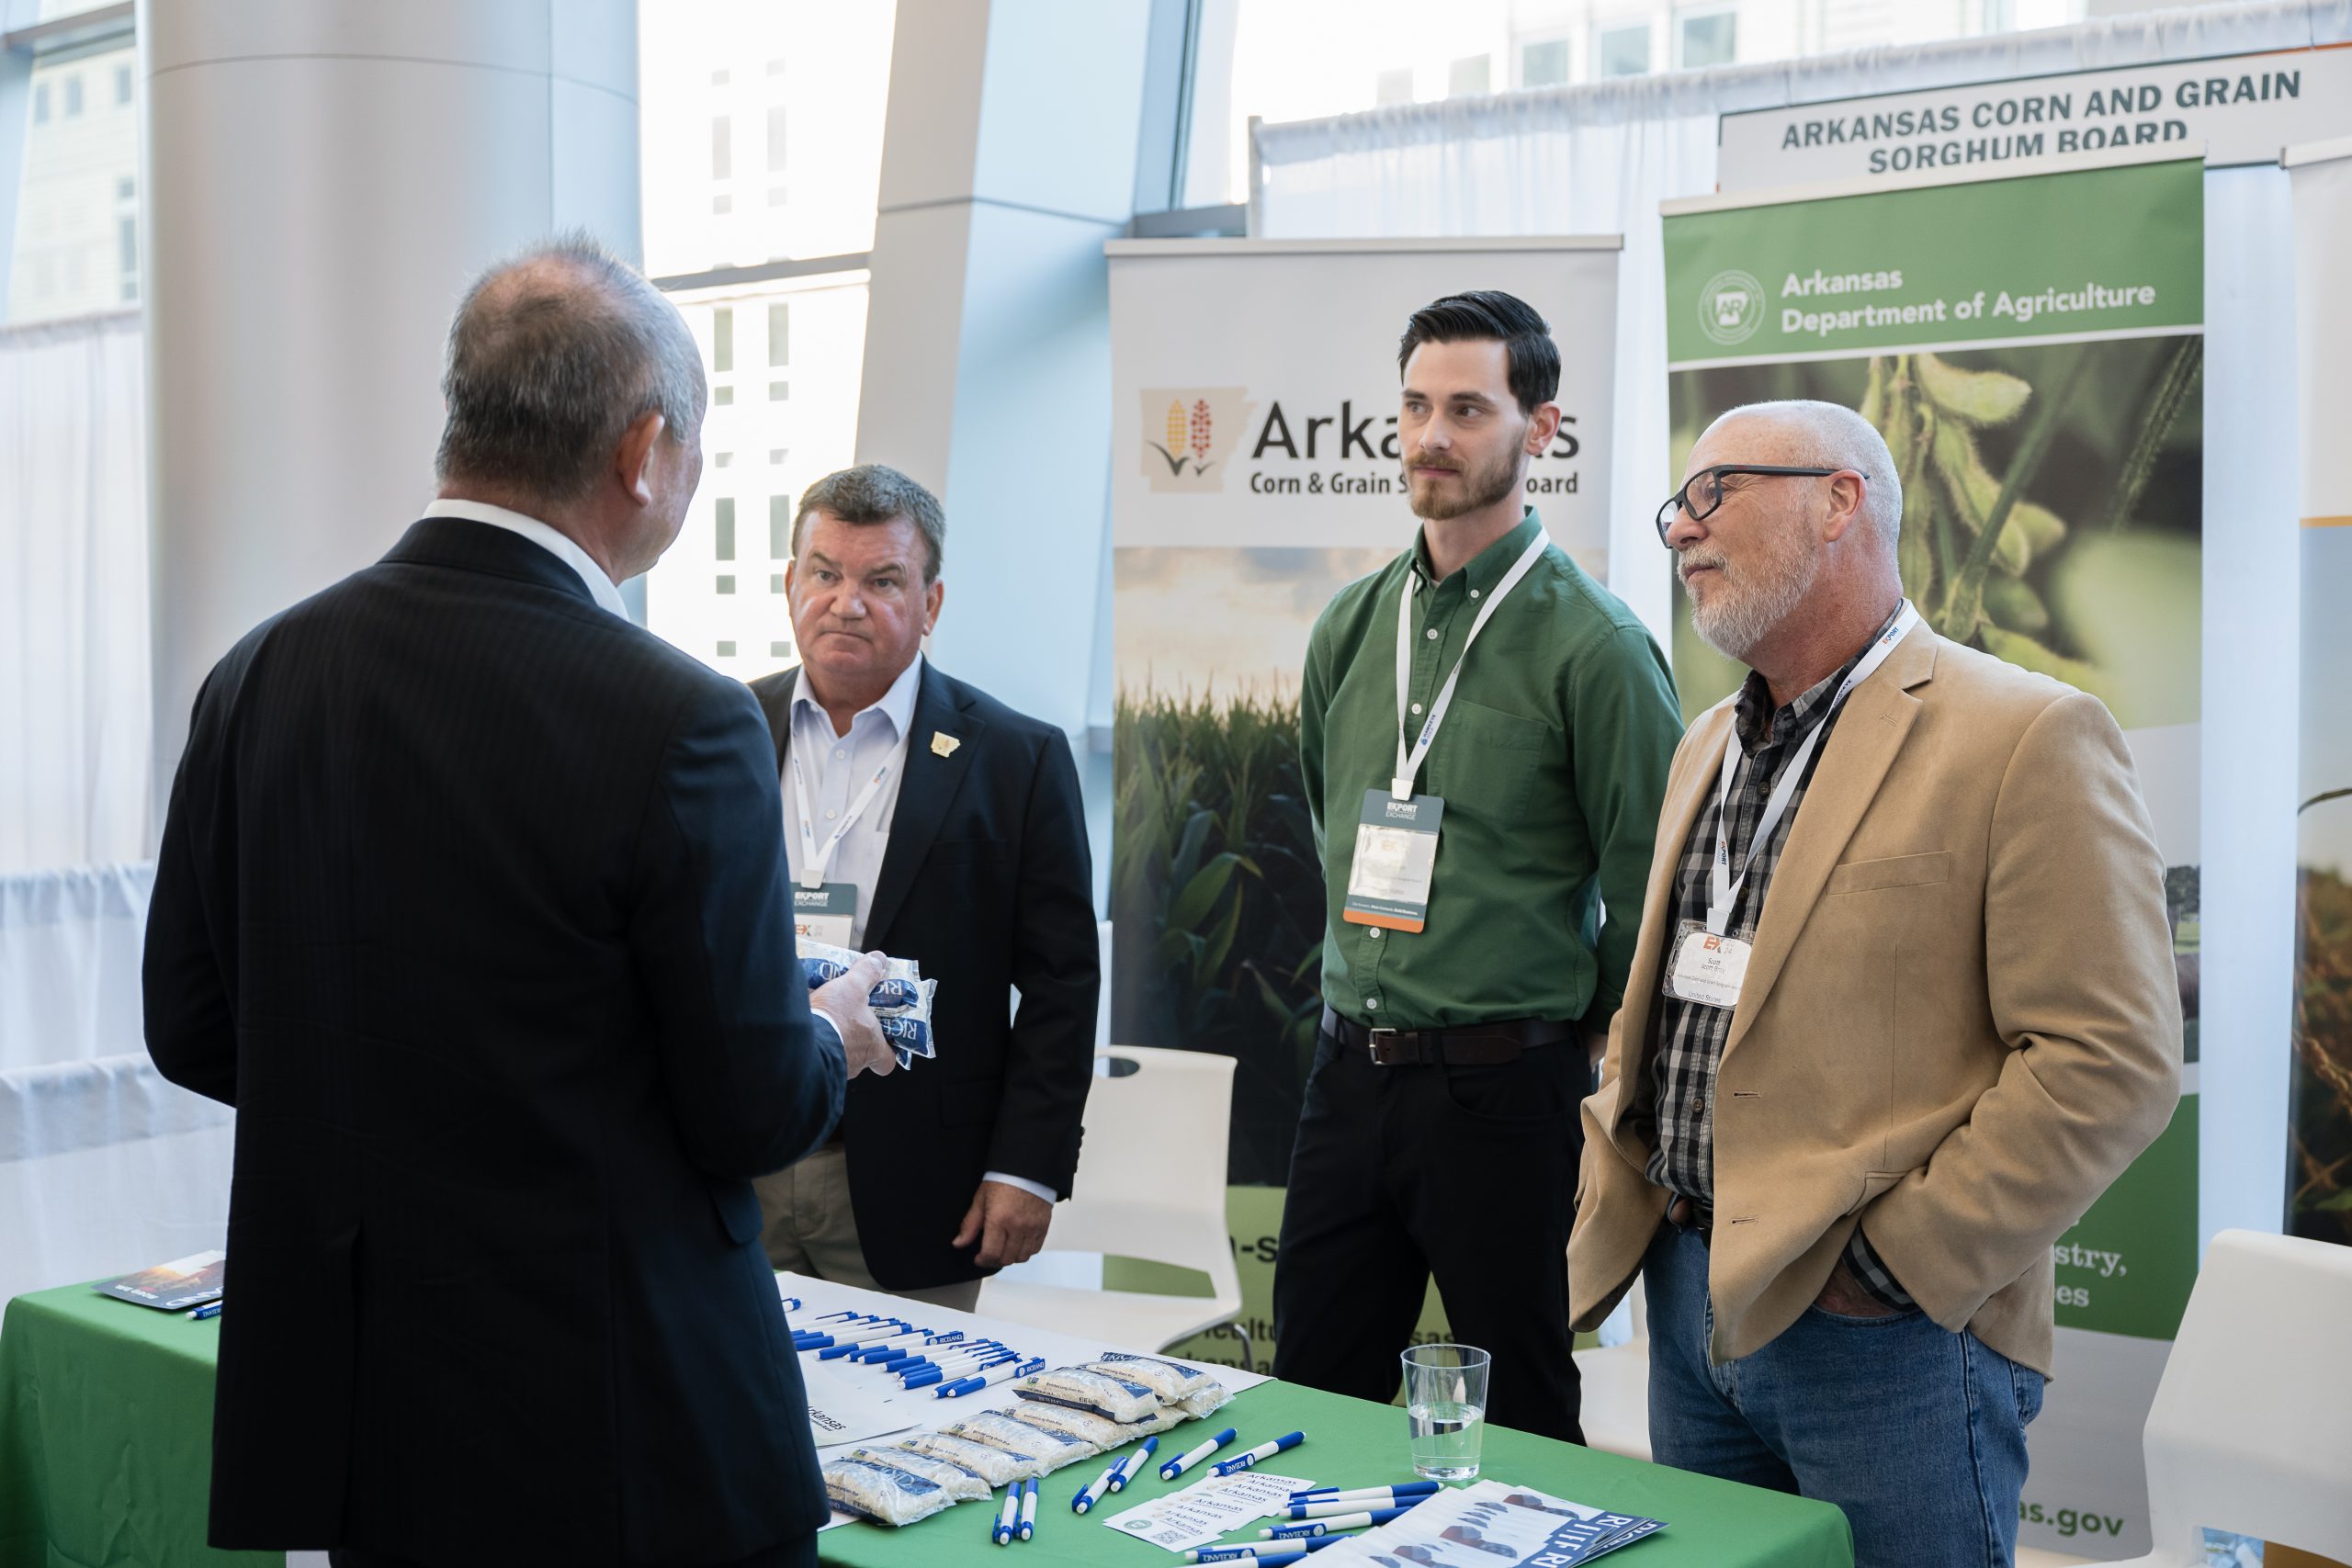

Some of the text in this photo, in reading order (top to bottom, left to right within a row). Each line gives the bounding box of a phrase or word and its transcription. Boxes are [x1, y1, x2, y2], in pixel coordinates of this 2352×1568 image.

[1782, 71, 2301, 149] ARKANSAS CORN AND GRAIN
[1869, 120, 2187, 174] SORGHUM BOARD
[1781, 269, 1903, 298] Arkansas
[1781, 299, 1947, 337] Department
[1954, 291, 1984, 320] of
[1992, 282, 2155, 322] Agriculture
[1250, 471, 1300, 493] Corn
[1308, 472, 1324, 493] &
[1331, 472, 1390, 493] Grain
[1526, 471, 1578, 493] oard
